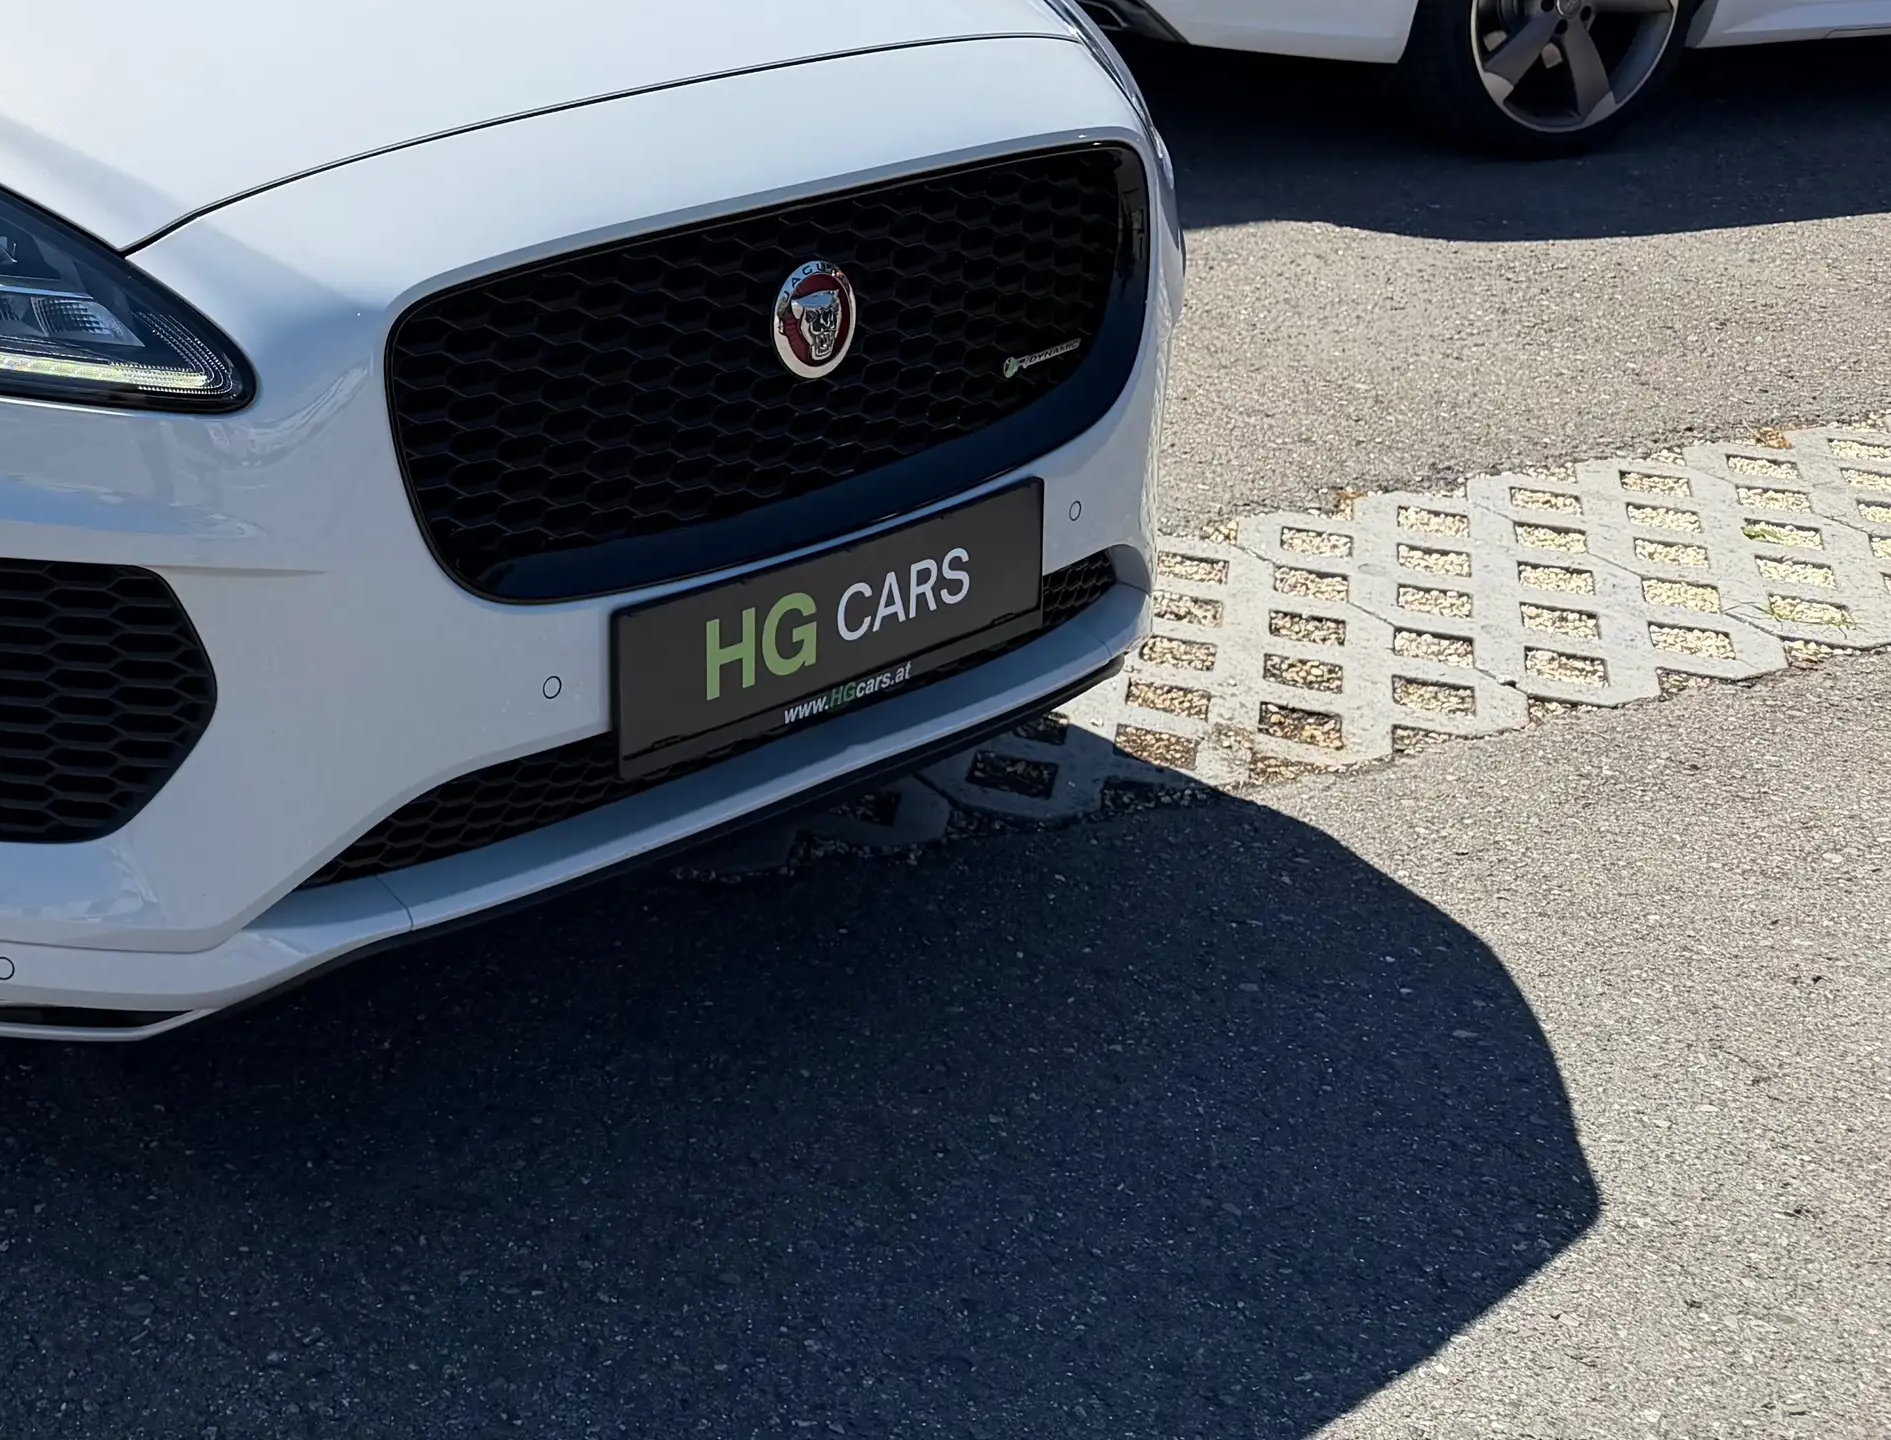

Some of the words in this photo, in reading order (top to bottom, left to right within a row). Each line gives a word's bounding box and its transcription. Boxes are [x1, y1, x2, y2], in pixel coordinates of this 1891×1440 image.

[705, 591, 817, 701] HG
[836, 547, 971, 642] CARS
[783, 661, 912, 725] www.HGcars.at
